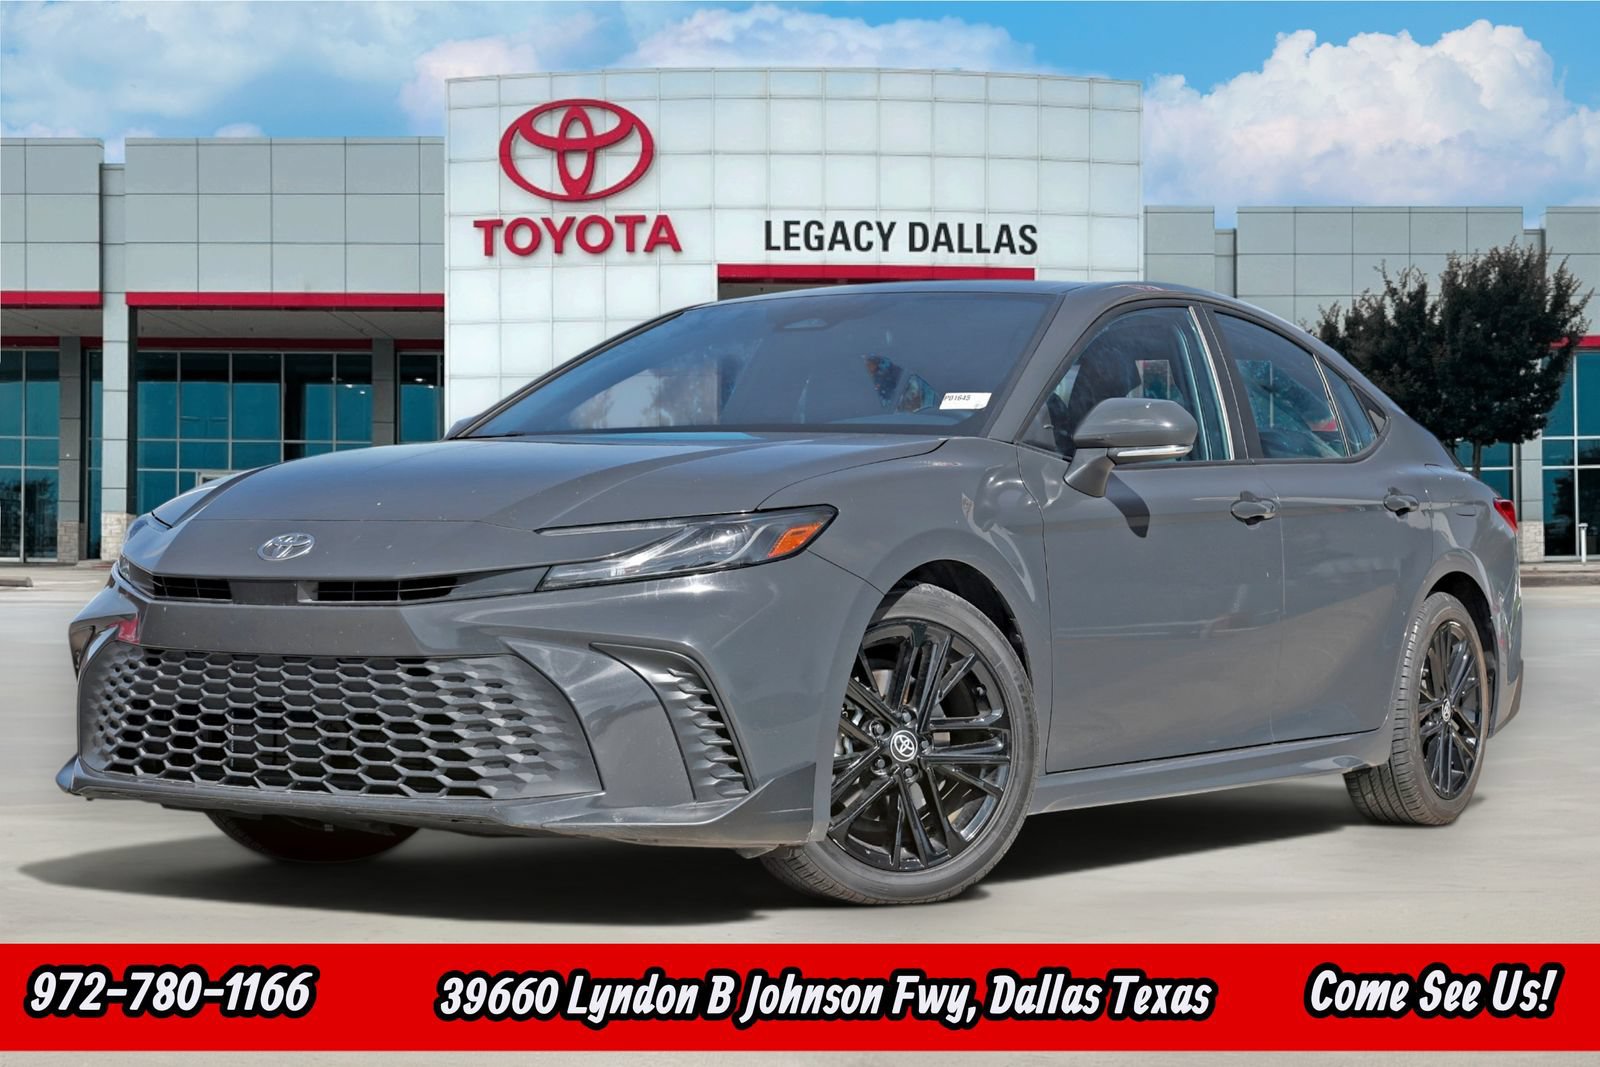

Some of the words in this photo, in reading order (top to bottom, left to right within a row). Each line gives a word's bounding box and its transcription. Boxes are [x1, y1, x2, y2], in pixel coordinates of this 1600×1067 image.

[473, 214, 682, 257] TOYOTA
[764, 220, 897, 252] LEGACY
[908, 222, 1038, 255] DALLAS
